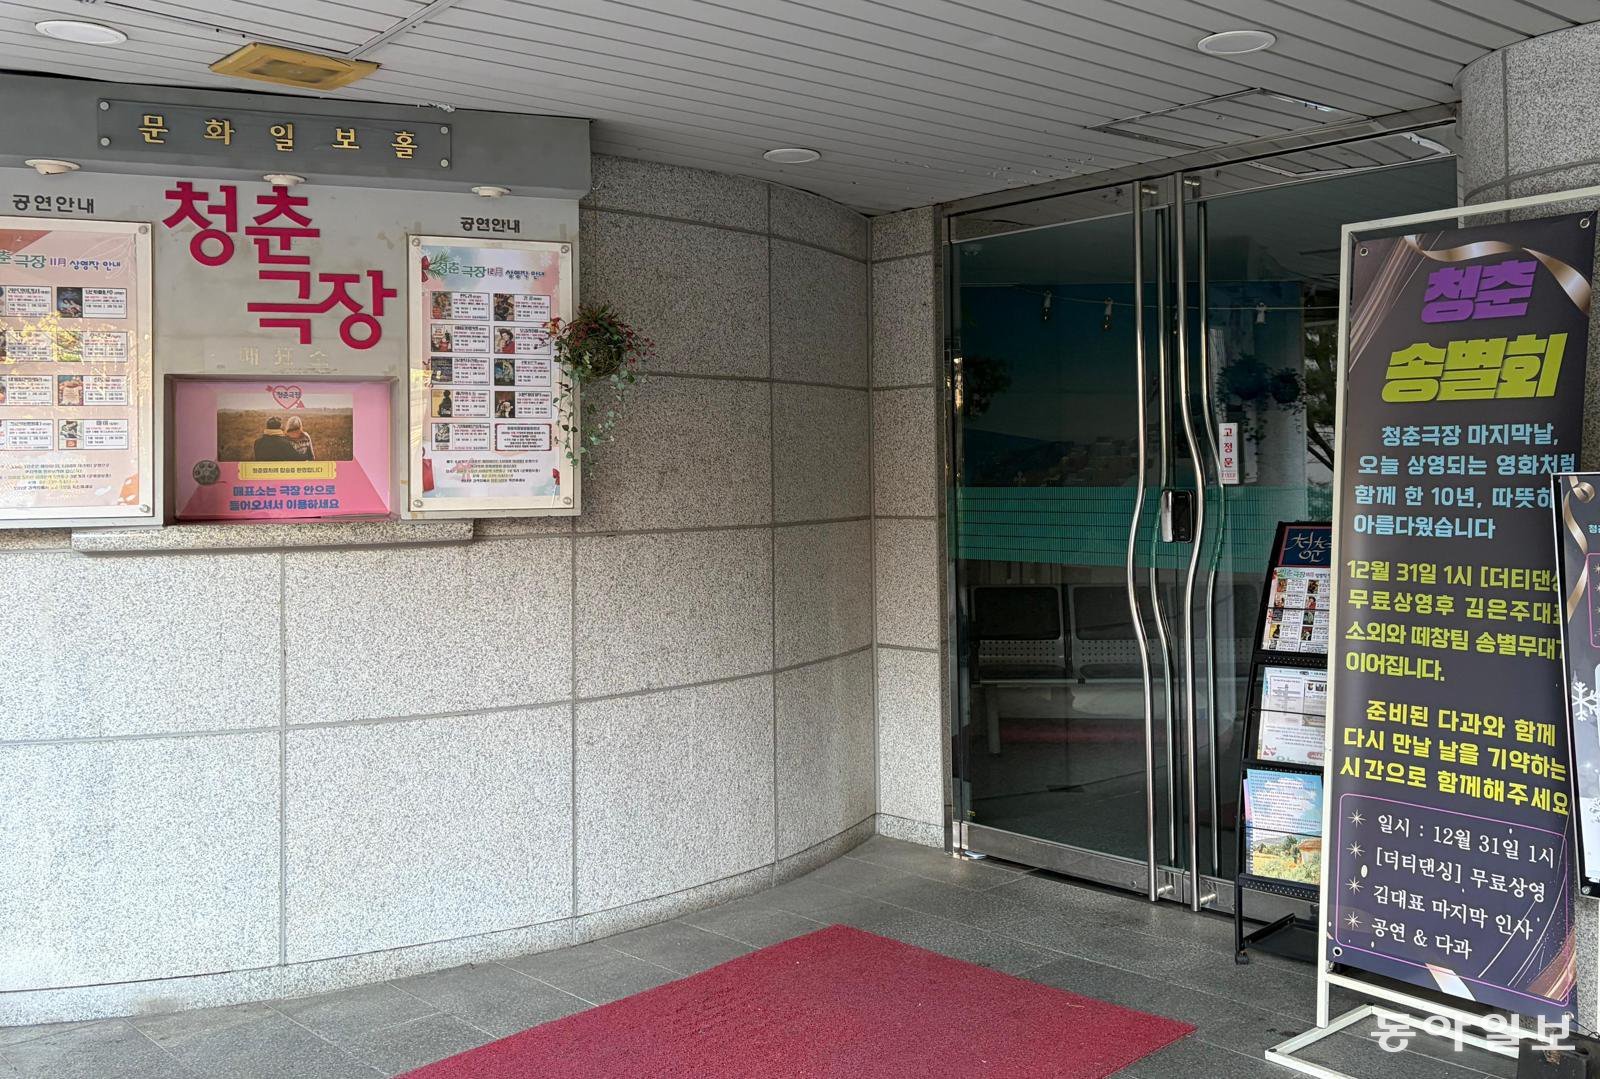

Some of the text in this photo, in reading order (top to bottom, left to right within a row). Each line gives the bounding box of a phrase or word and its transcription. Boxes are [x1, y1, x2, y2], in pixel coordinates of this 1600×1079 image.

[12, 193, 95, 215] 공연안내
[162, 181, 320, 266] 청춘
[460, 216, 520, 233] 공연안내
[102, 260, 121, 271] 안내
[247, 269, 397, 350] 극장
[1421, 260, 1537, 323] 청춘
[1381, 333, 1568, 403] 송별회
[1223, 427, 1233, 468] 고정문
[1381, 422, 1558, 447] 청춘극장 마지막날,
[1358, 452, 1575, 476] 오늘 상영되는 영화처럼
[232, 484, 336, 497] 매표소는 극장 안으로
[286, 499, 340, 510] 이용하세요
[1355, 485, 1396, 506] 함께
[1404, 486, 1423, 507] 한
[1431, 486, 1482, 509] 10년,
[1353, 515, 1496, 539] 아름다웠습니다
[1346, 560, 1389, 582] 12월
[1396, 562, 1436, 585] 31일
[1444, 563, 1472, 586] 1시
[1348, 589, 1454, 615] 무료상영후
[1345, 621, 1407, 645] 소외와
[1411, 625, 1469, 651] 떼창팀
[1475, 632, 1563, 660] 송별무대
[1346, 651, 1445, 681] 이어집니다.
[1366, 699, 1556, 747] 준비된 다과와 함께
[1343, 727, 1384, 751] 다시
[1392, 732, 1432, 759] 만날
[1439, 739, 1480, 766] 날을
[1487, 746, 1567, 782] 기약하는
[1340, 756, 1569, 815] 시간으로 함께해주세요
[1377, 814, 1410, 838] 일시
[1433, 824, 1471, 851] 12월
[1478, 833, 1519, 861] 31일
[1528, 845, 1555, 869] 1시
[1376, 847, 1545, 903] [더티댄싱] 무료상영
[1373, 885, 1533, 941] 김대표 마지막 인사
[1371, 917, 1473, 960] 공연 & 다과
